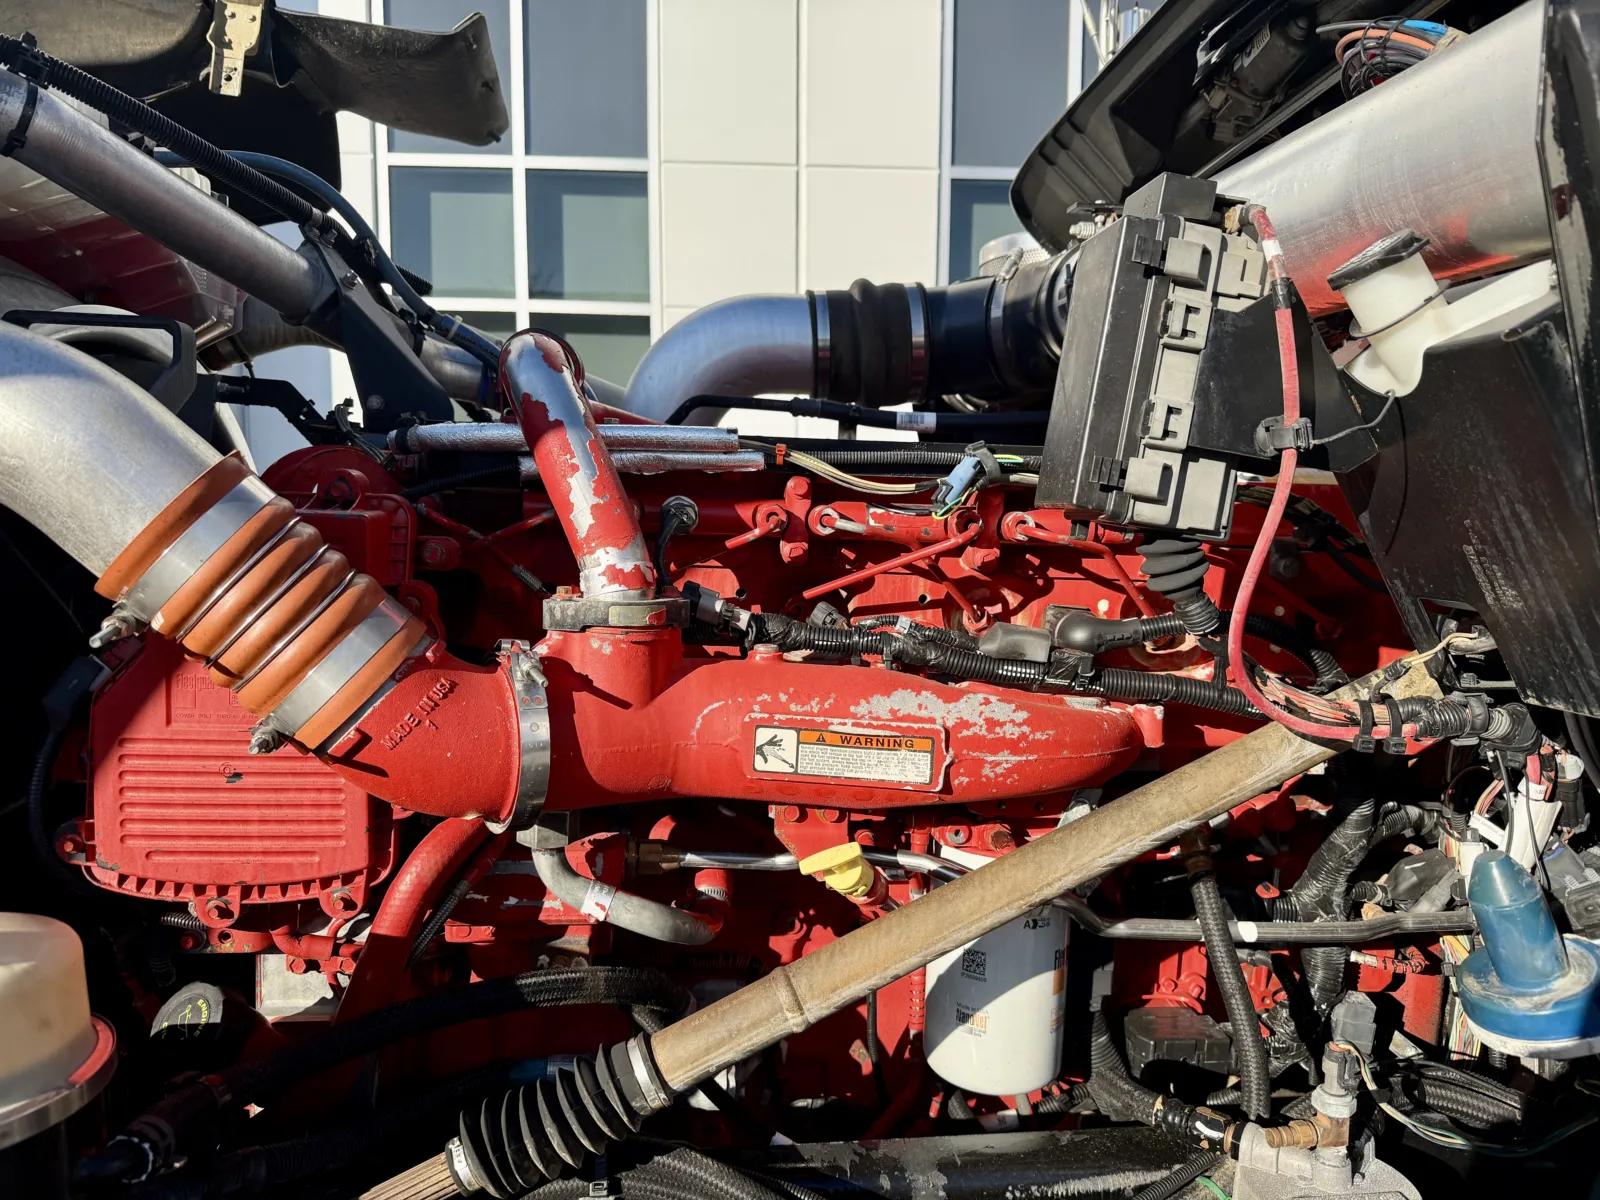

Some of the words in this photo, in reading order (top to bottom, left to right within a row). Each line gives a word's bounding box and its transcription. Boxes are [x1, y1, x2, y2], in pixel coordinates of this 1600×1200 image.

[380, 712, 419, 750] MADE
[416, 694, 435, 715] IN
[428, 678, 451, 700] USA
[840, 735, 914, 749] WARNING
[193, 998, 208, 1038] ENGINE
